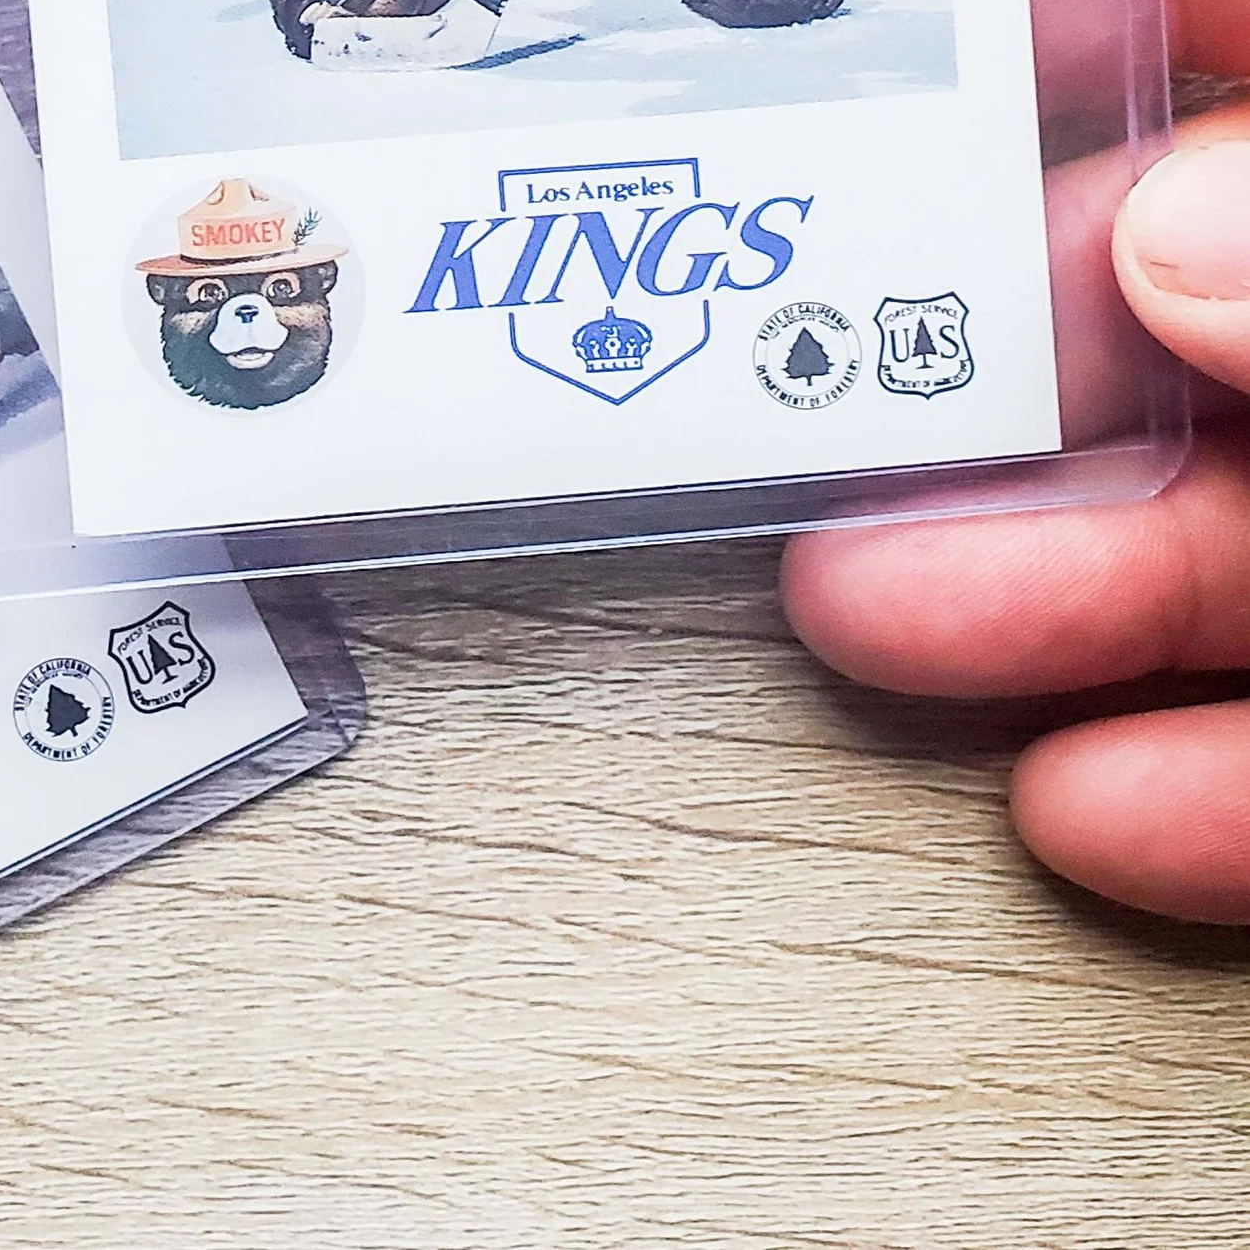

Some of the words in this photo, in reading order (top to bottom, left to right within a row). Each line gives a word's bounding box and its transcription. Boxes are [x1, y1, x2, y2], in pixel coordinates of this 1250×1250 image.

[527, 183, 570, 203] Los
[575, 177, 674, 203] Angeles
[191, 218, 285, 246] SMOKEY
[402, 195, 815, 313] KINGS
